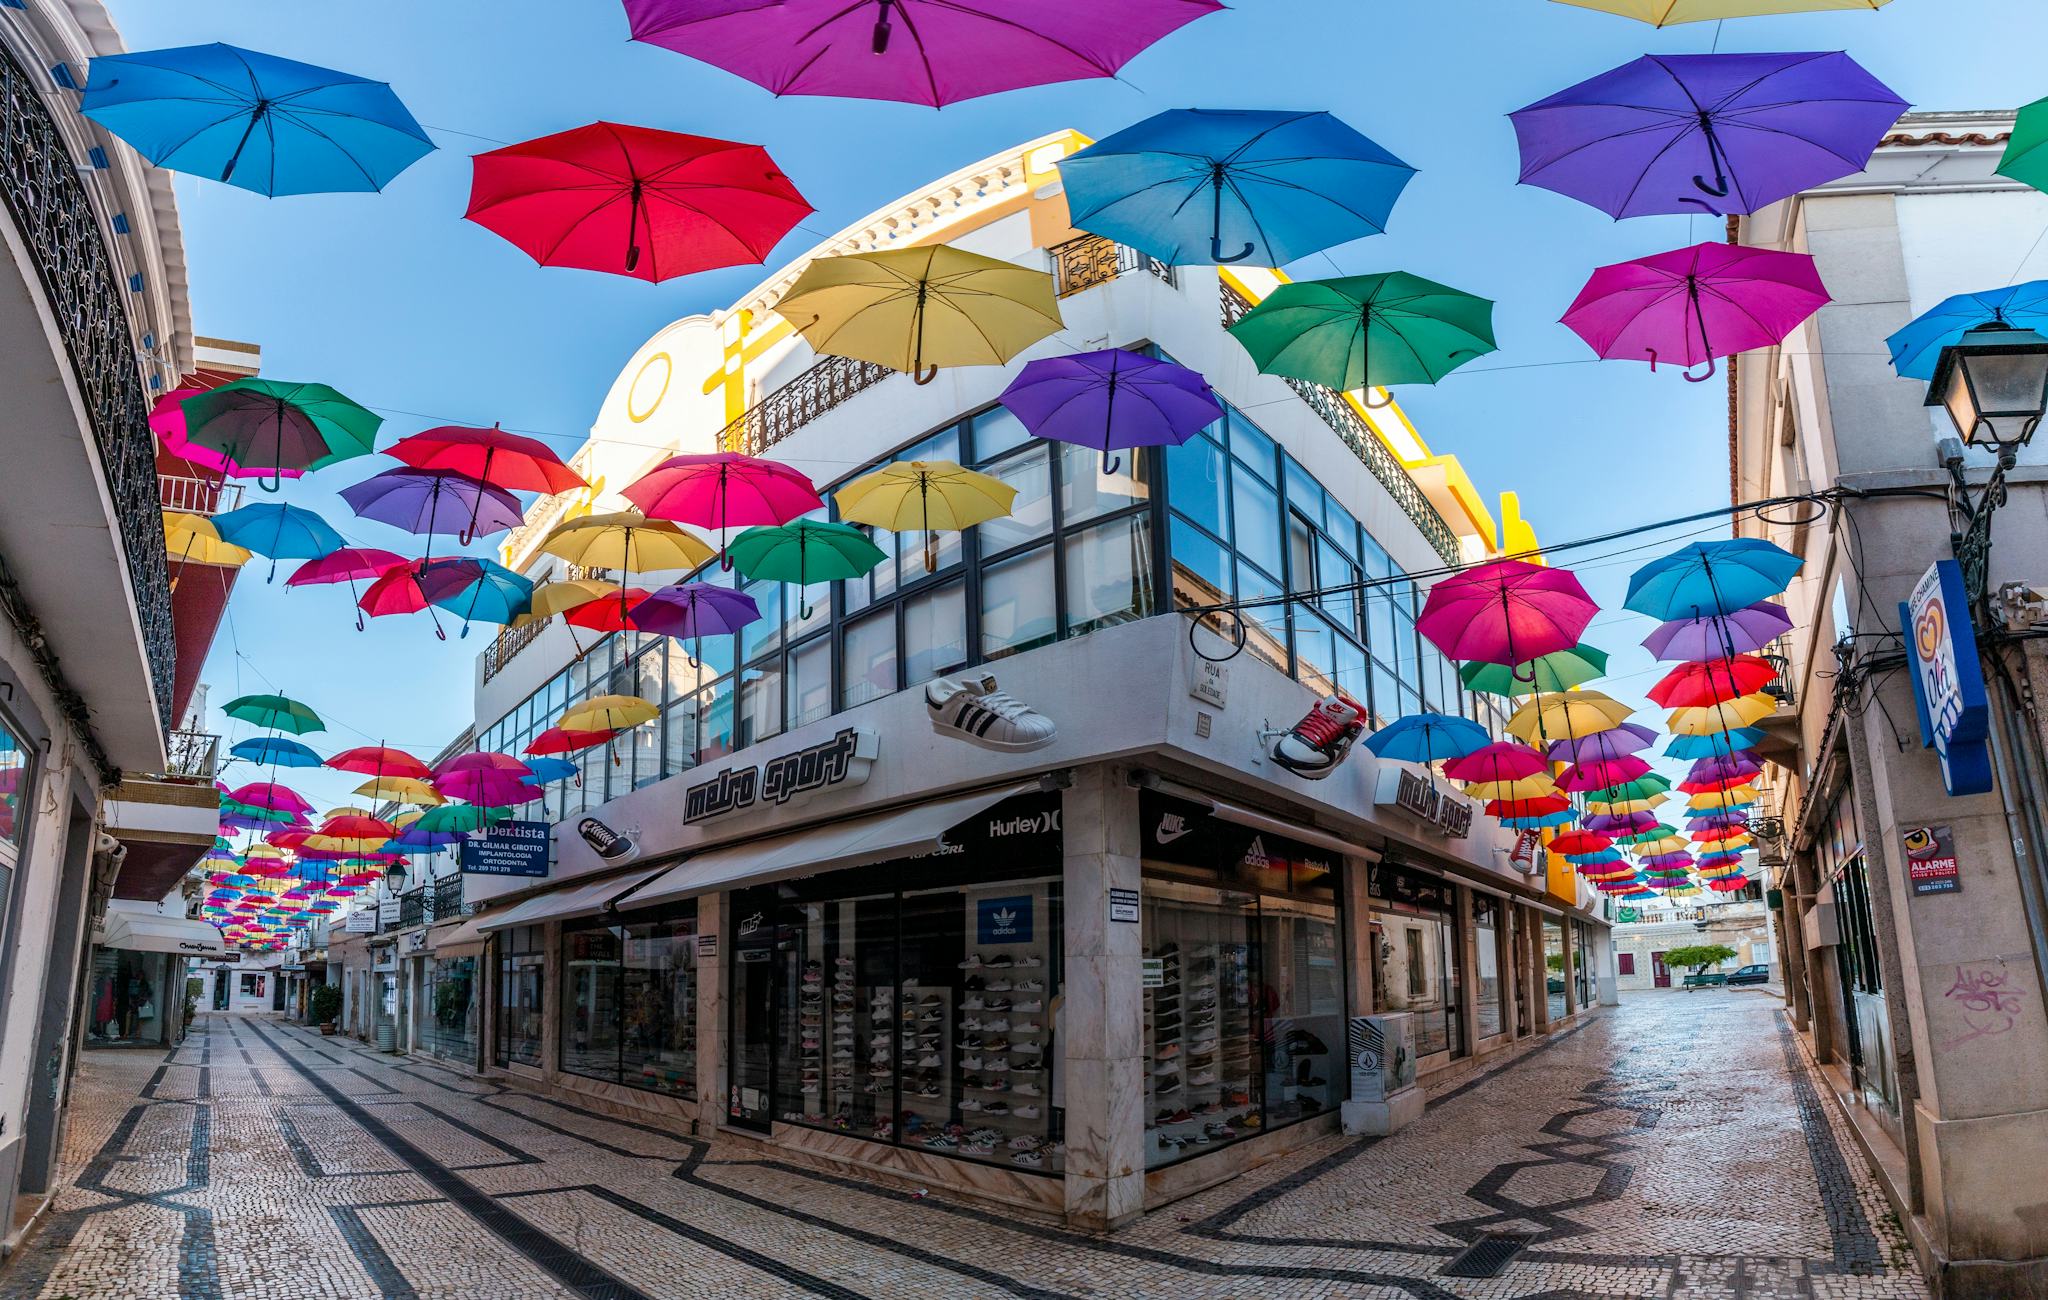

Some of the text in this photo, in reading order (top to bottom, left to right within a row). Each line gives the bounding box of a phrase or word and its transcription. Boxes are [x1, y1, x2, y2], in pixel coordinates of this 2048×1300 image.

[1204, 662, 1220, 679] RUA
[1928, 653, 1952, 709] Olá
[1200, 683, 1221, 699] SOLEDADE
[683, 726, 858, 825] metro sport
[989, 816, 1041, 838] Hurley
[1161, 812, 1186, 834] NIKE
[488, 826, 546, 839] Dentista
[468, 840, 544, 852] DR. GILMAR GIROTTO
[478, 850, 533, 859] IMPLANTOLOGIA
[483, 858, 528, 866] ORTODONTIA
[1244, 854, 1270, 869] adidas
[1304, 857, 1324, 872] Reebok
[1912, 859, 1954, 871] ALARME
[992, 926, 1016, 935] adidas
